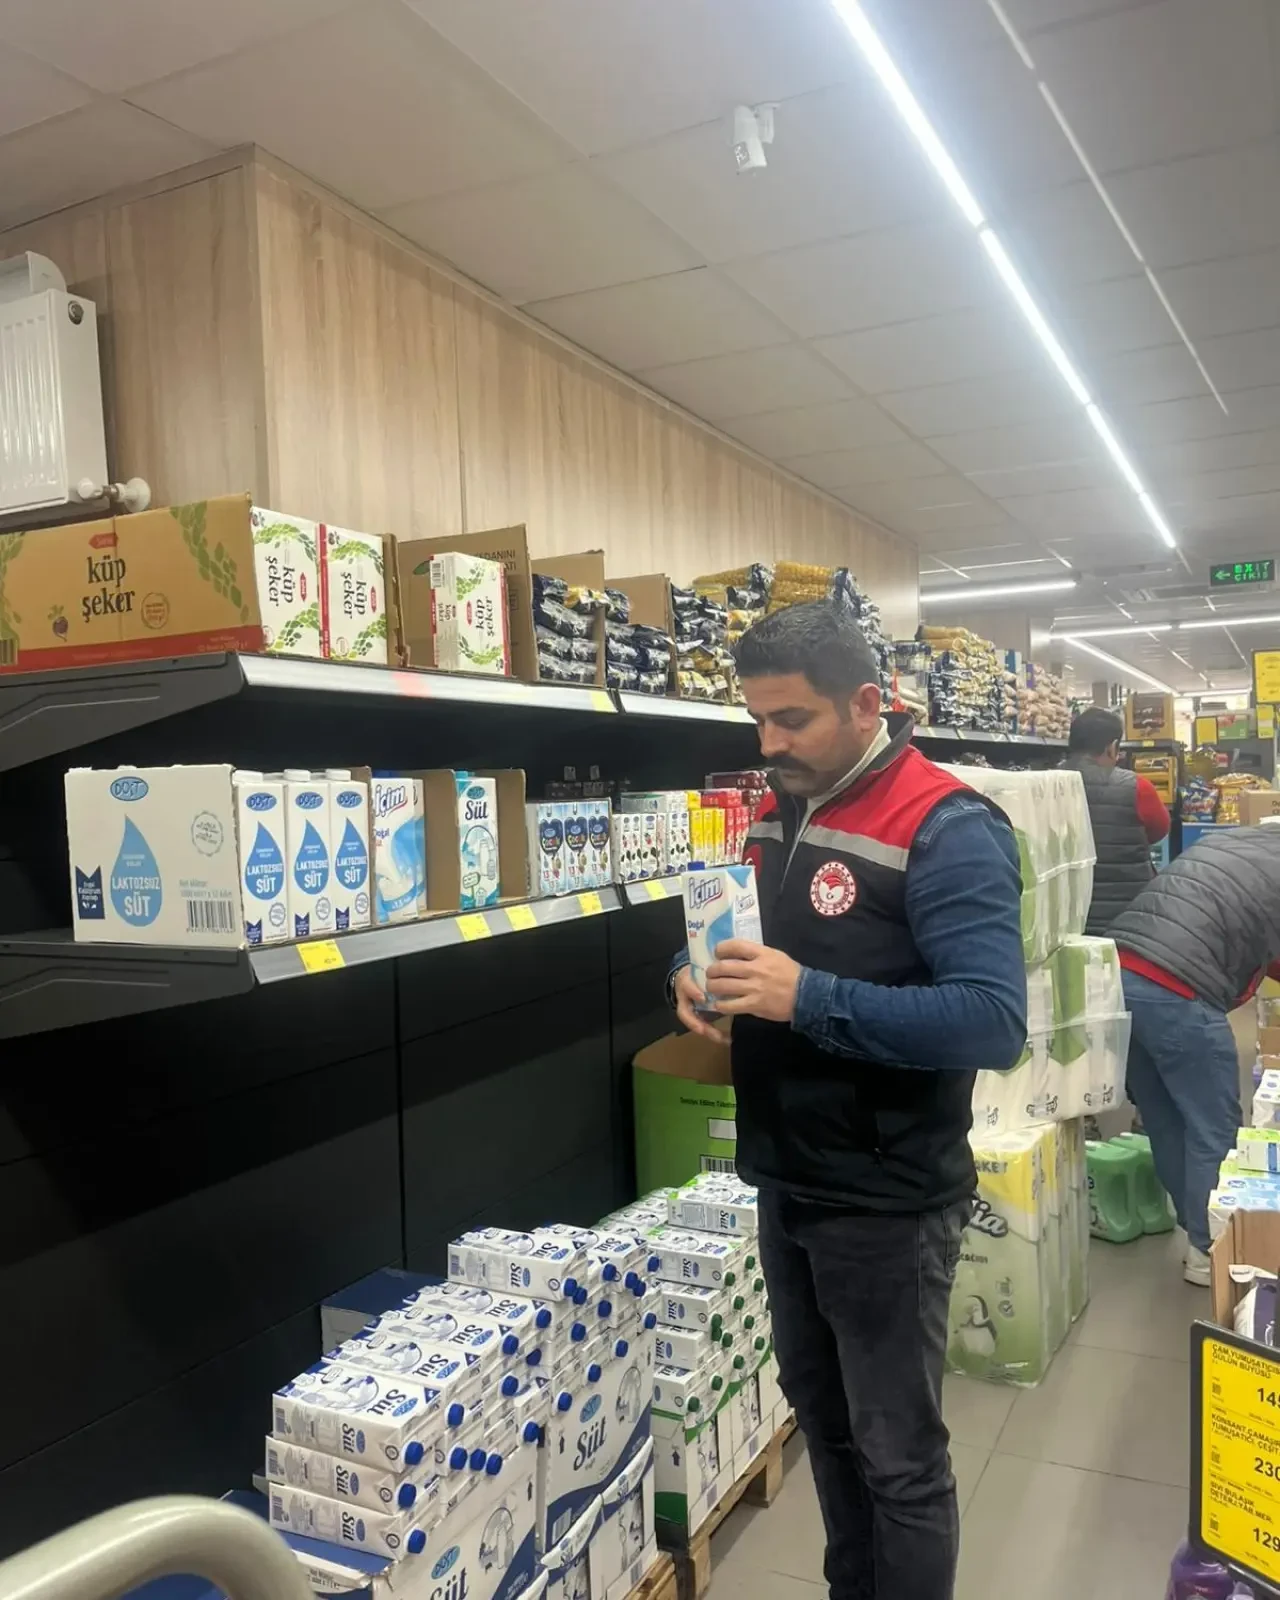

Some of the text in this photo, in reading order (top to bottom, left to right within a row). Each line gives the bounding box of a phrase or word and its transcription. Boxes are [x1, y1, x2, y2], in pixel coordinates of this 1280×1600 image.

[87, 554, 126, 588] küp
[265, 555, 281, 607] şeker
[1233, 562, 1270, 574] EXIT
[281, 565, 296, 603] küp
[341, 571, 354, 619] şeker
[82, 587, 135, 623] şeker
[354, 580, 368, 615] küp
[465, 800, 489, 820] Süt
[112, 876, 160, 890] LAKTOZSUZ
[256, 874, 277, 894] SÜT
[304, 869, 322, 888] SÜT
[344, 867, 361, 884] SÜT
[124, 891, 151, 917] SÜT
[412, 1353, 449, 1377] Süt
[367, 1389, 407, 1415] Süt
[342, 1423, 355, 1453] Süt
[573, 1416, 607, 1471] Süt
[336, 1464, 349, 1496] Süt
[1254, 1457, 1280, 1482] 230
[342, 1511, 355, 1541] Süt
[1253, 1527, 1280, 1552] 129
